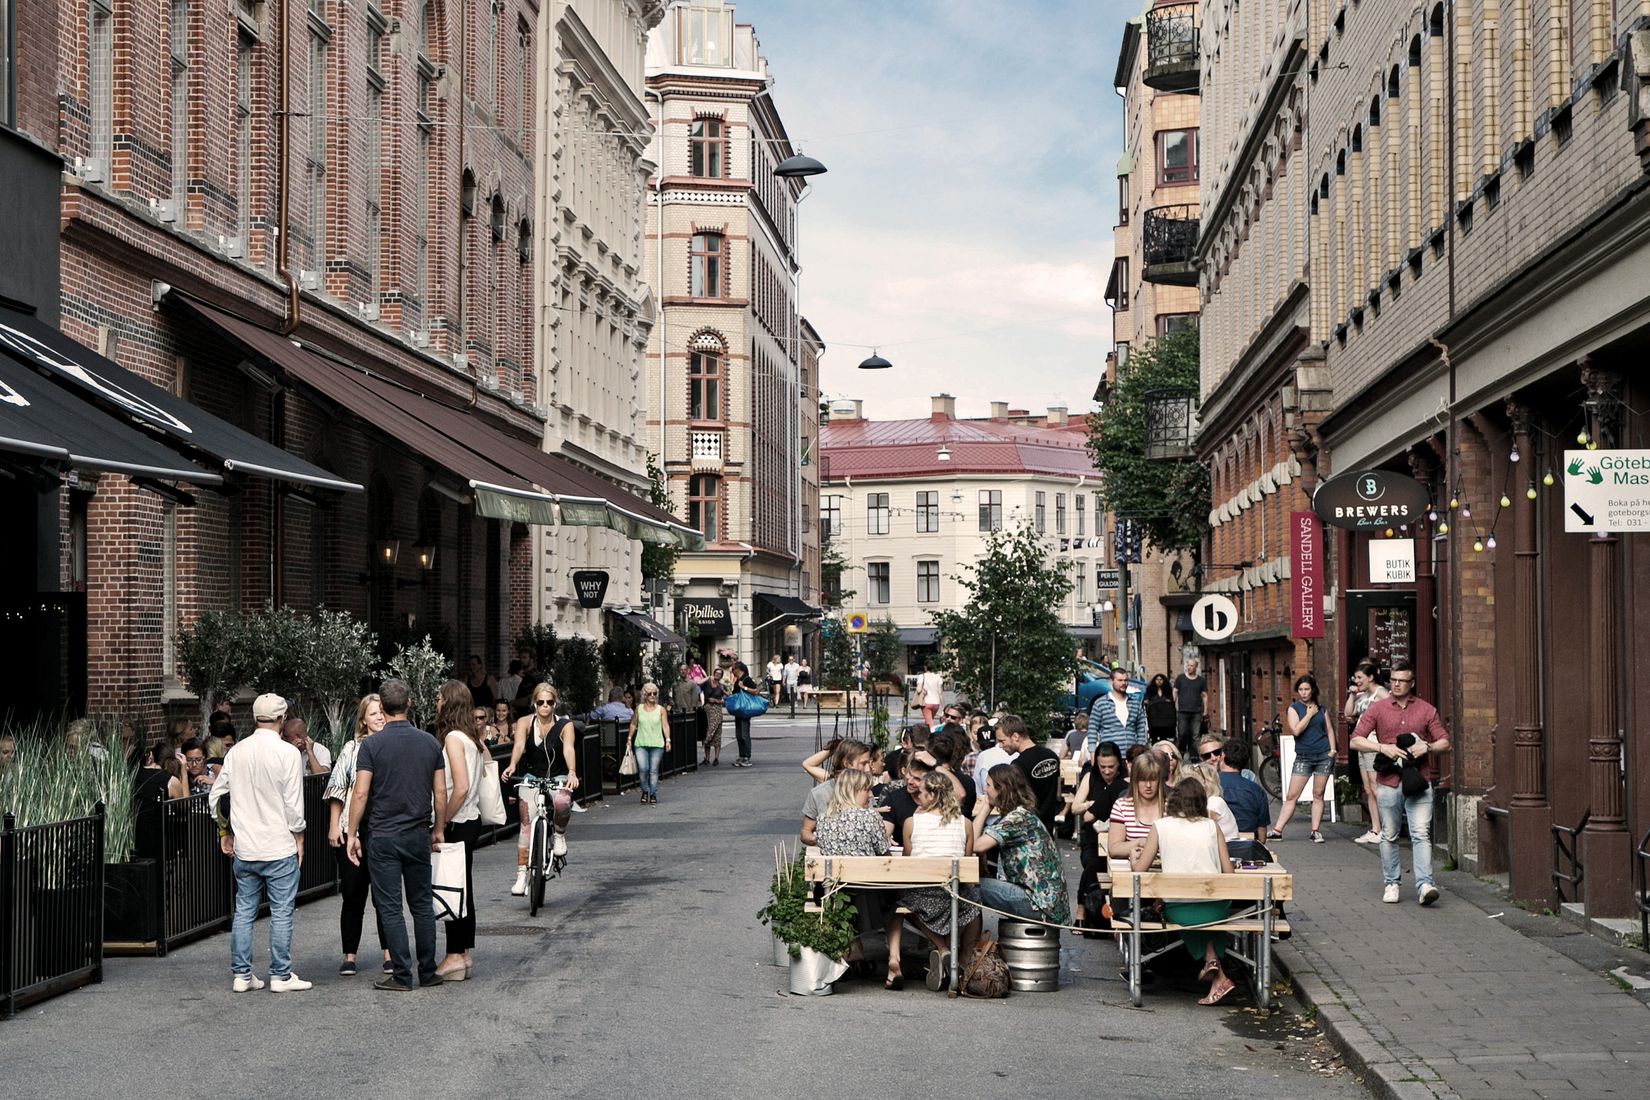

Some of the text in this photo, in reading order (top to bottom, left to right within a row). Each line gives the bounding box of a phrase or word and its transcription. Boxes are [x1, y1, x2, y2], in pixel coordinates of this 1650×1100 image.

[1614, 472, 1649, 484] Mas
[1630, 499, 1640, 508] på
[1335, 505, 1408, 518] BREWERS
[1608, 509, 1650, 518] goteborgs
[1386, 560, 1410, 568] BUTIK
[1300, 518, 1314, 630] SANDELL GALLERY
[1386, 570, 1412, 579] KUBIK
[580, 581, 602, 590] WHY
[982, 731, 991, 740] W
